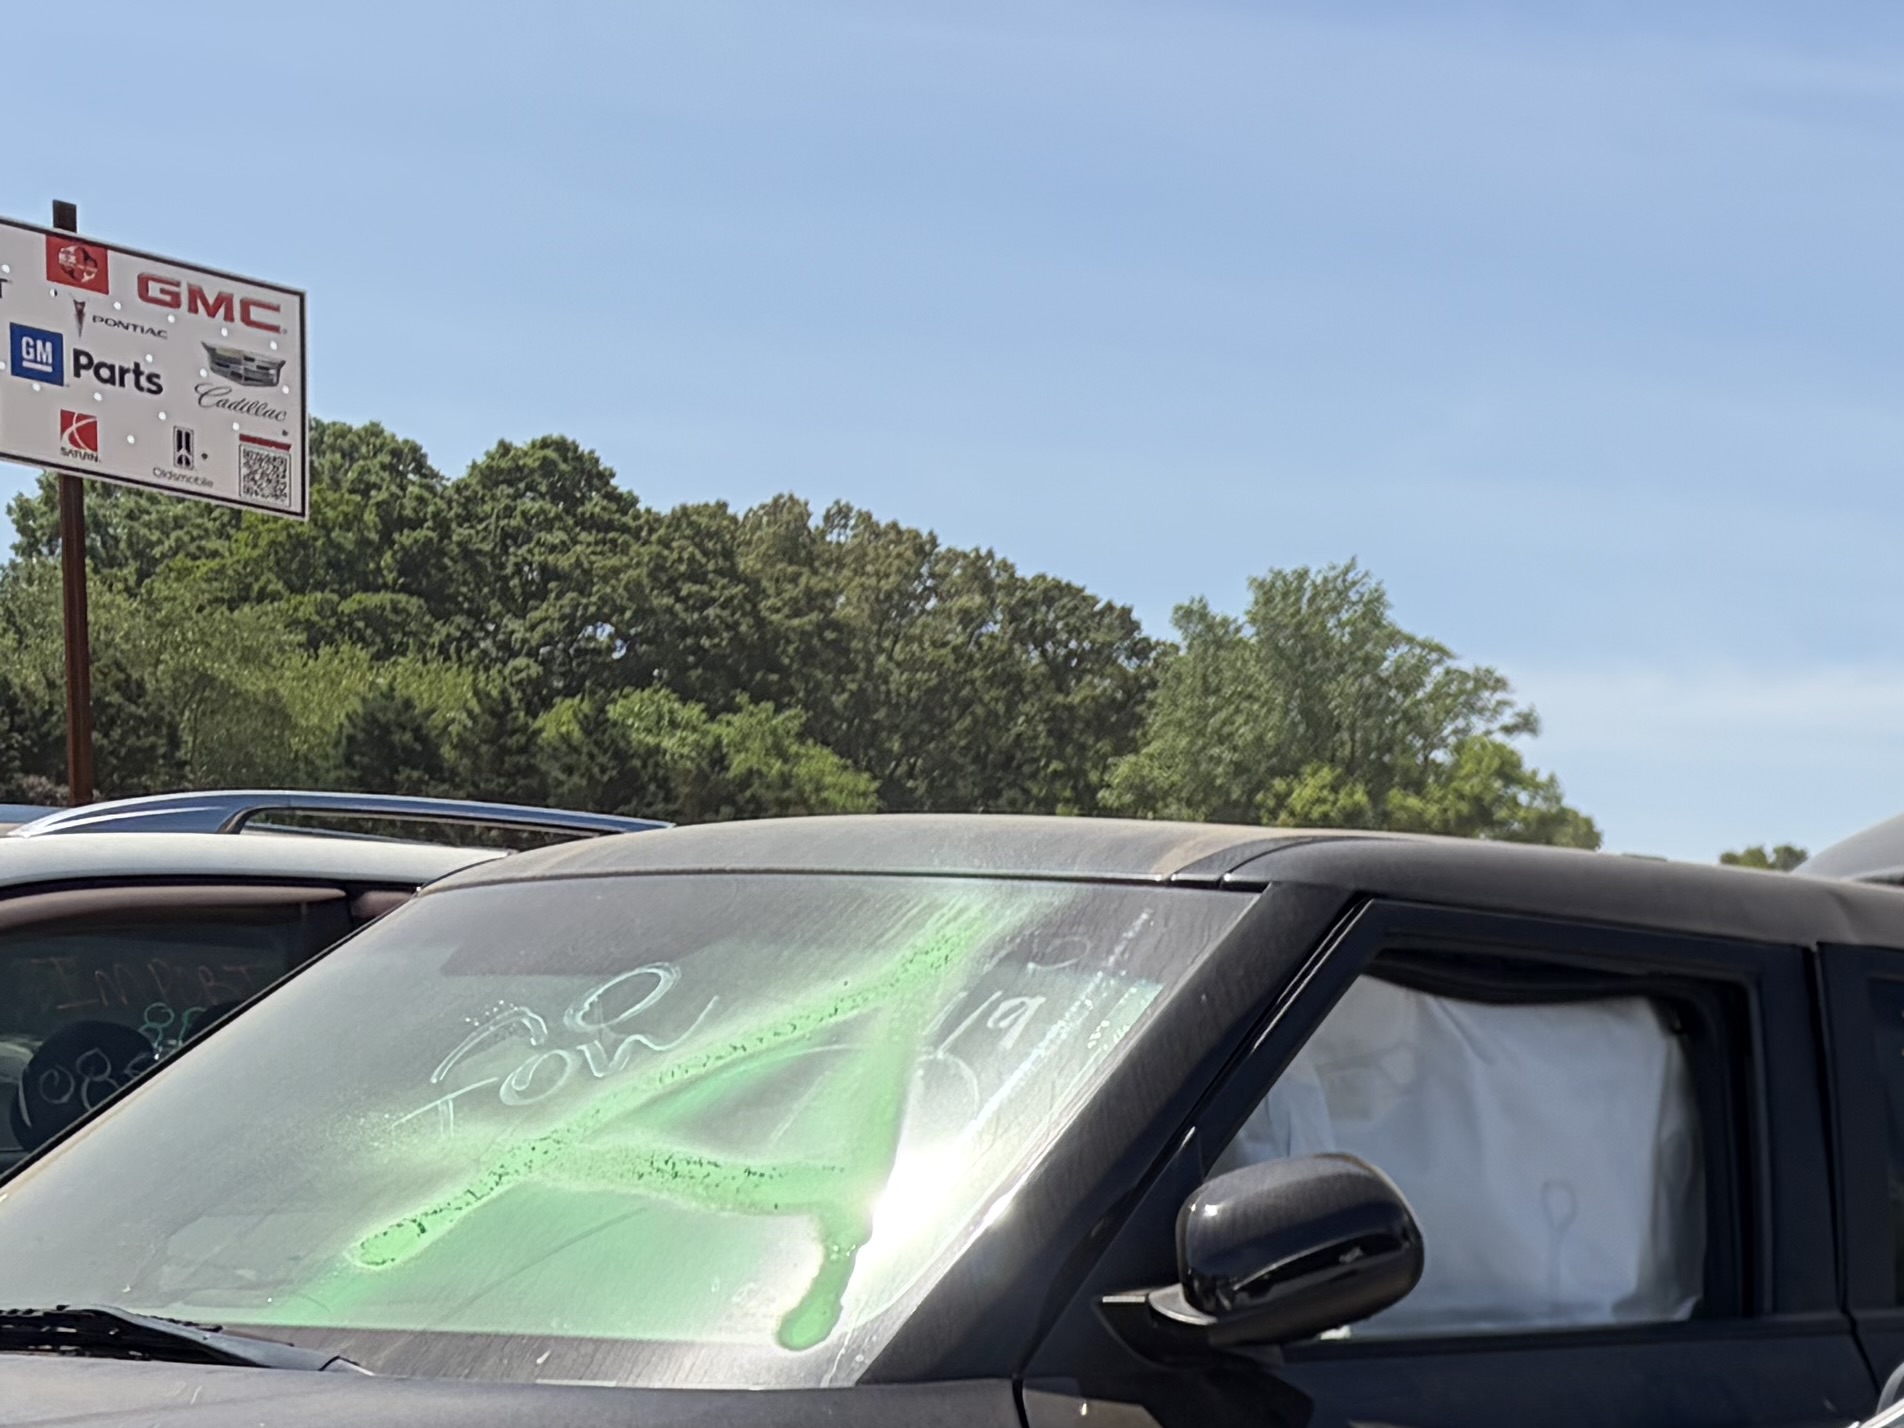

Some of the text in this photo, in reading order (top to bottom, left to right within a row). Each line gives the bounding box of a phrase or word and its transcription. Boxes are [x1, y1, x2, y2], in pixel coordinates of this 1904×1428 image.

[92, 315, 168, 340] PONTIAC
[137, 272, 281, 334] GMC
[21, 336, 163, 395] GM Parts
[194, 383, 287, 422] Cadillac
